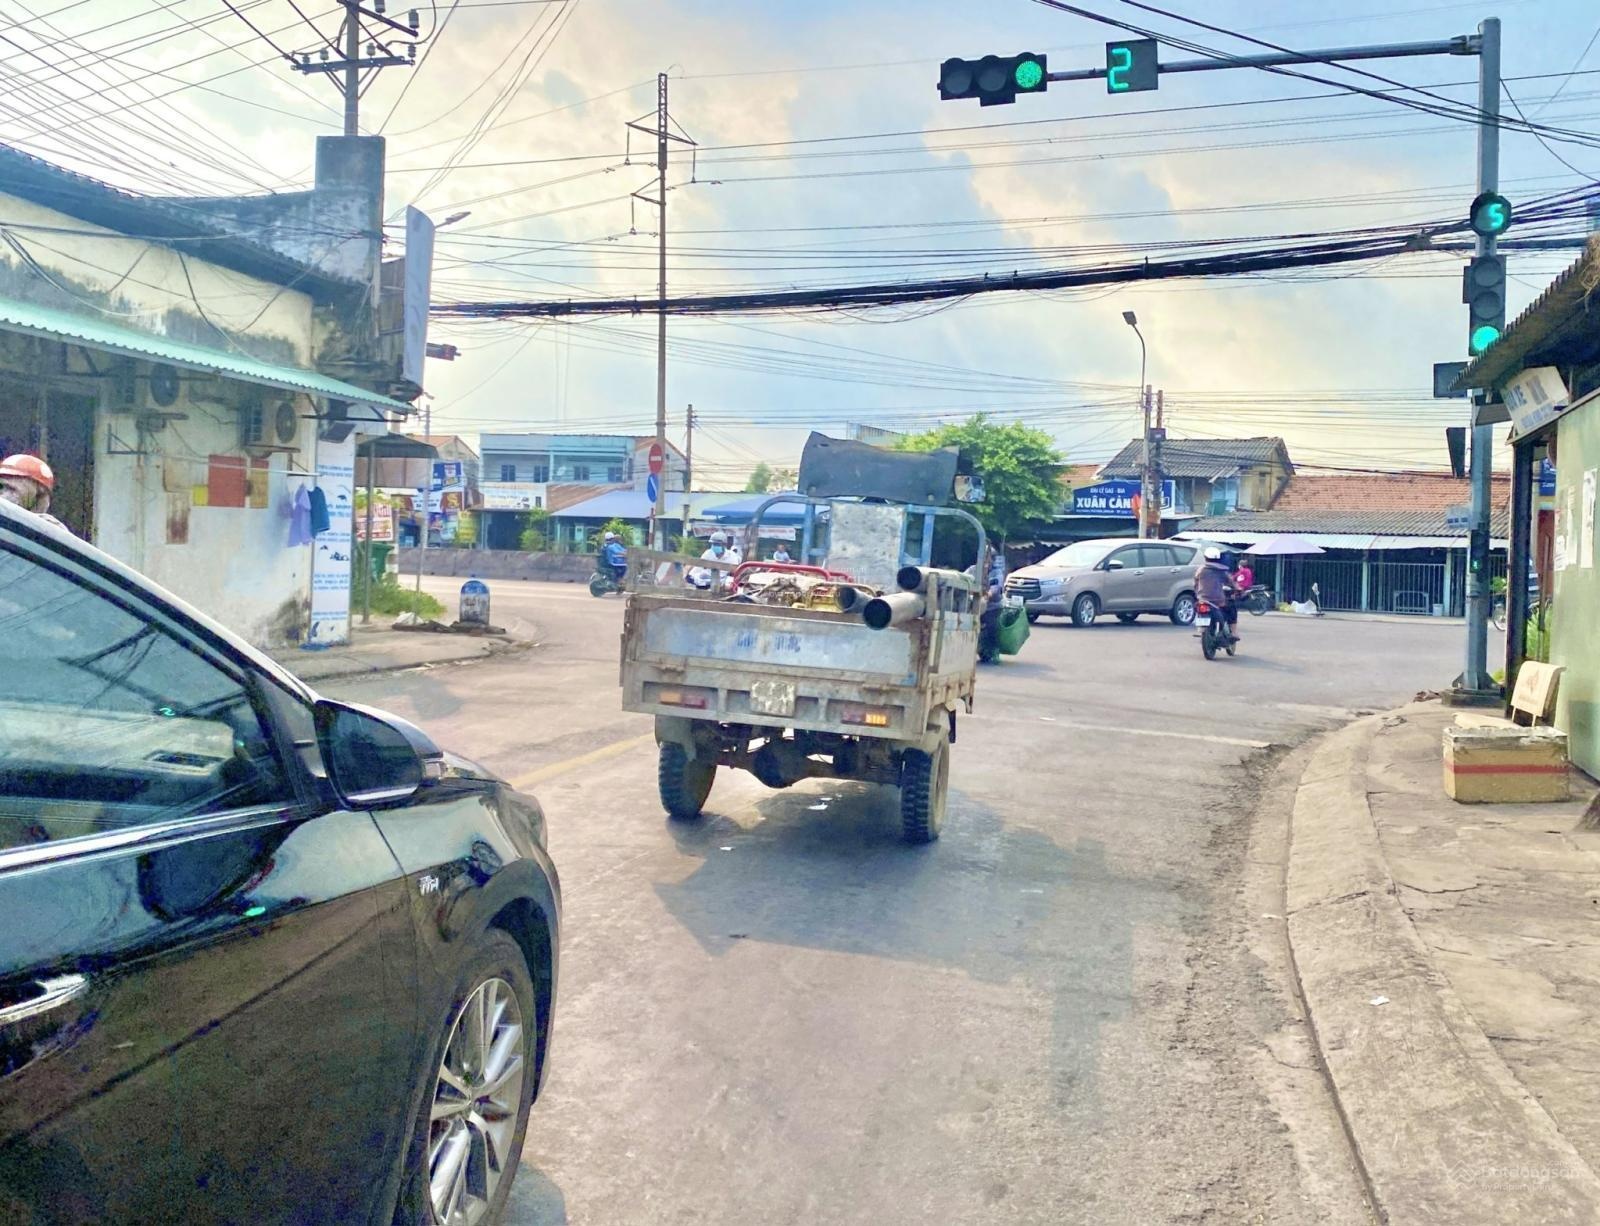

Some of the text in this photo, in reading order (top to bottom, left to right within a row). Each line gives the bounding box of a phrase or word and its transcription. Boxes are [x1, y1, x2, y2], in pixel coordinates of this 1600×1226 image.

[1109, 47, 1132, 89] 2
[1488, 203, 1504, 229] 5
[1076, 495, 1107, 508] XUÂN
